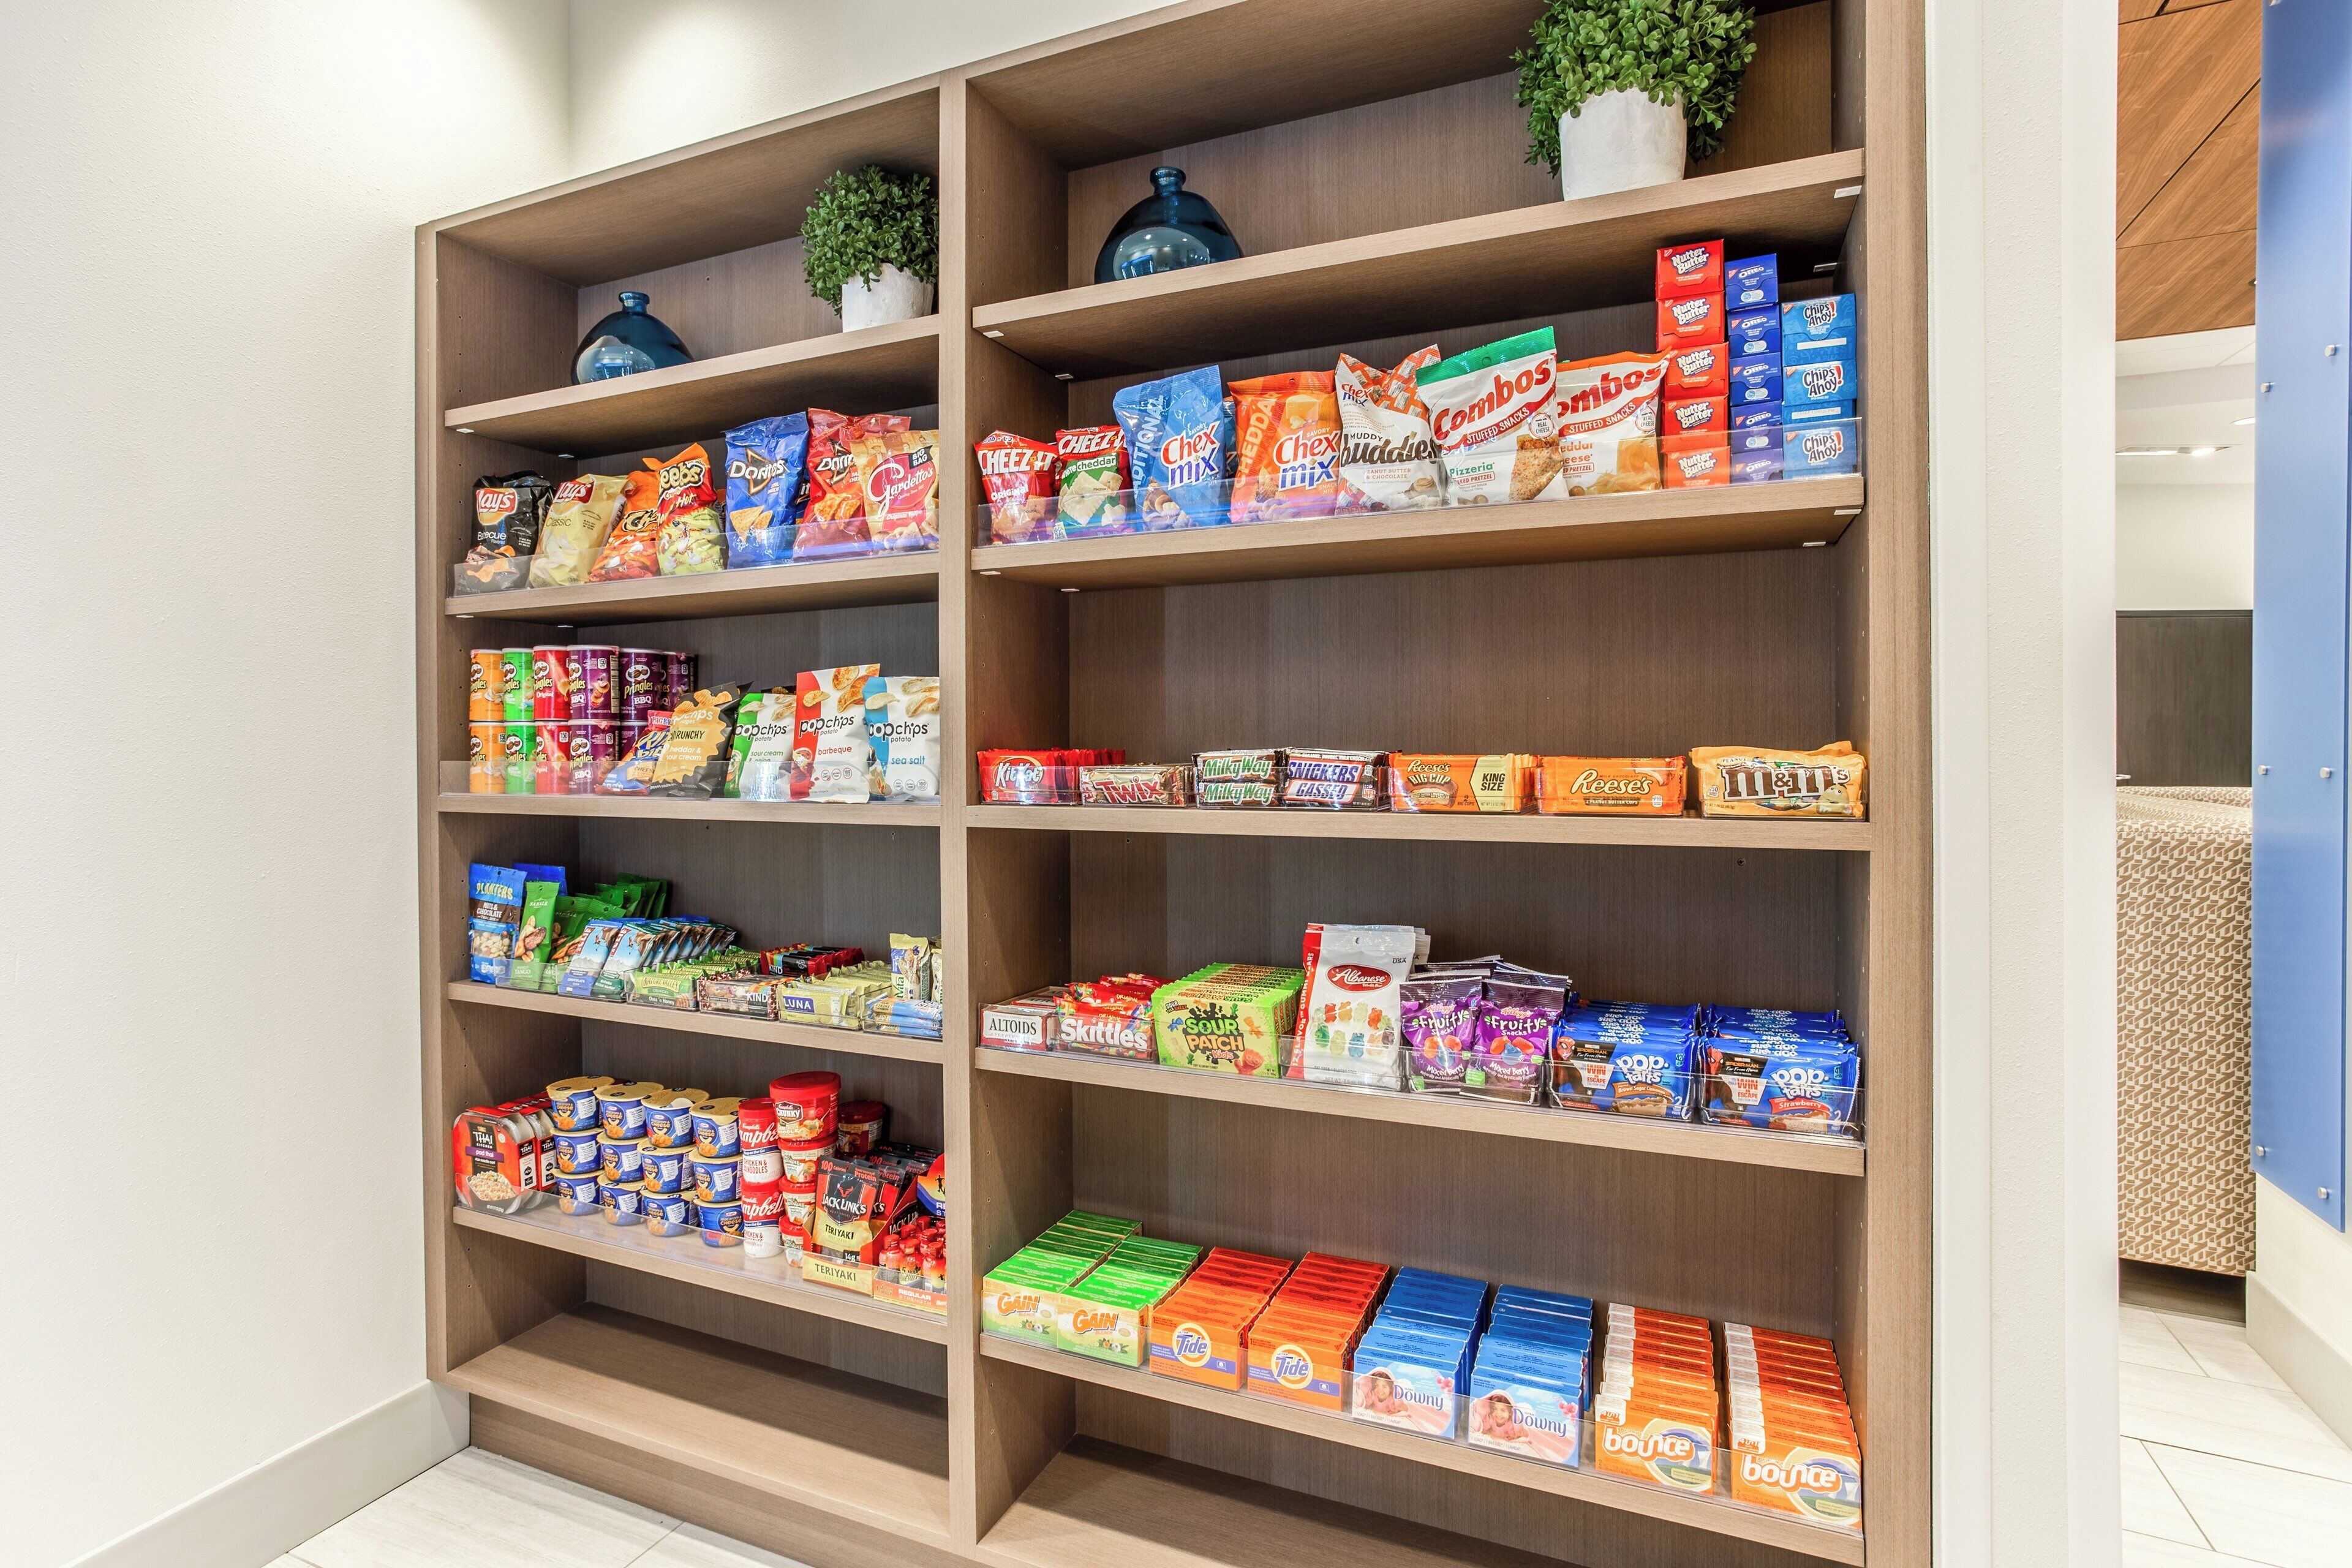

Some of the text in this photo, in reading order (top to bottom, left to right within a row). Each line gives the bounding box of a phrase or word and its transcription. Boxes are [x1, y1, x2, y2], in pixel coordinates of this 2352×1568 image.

[1672, 247, 1705, 266] Nutter
[1677, 254, 1709, 274] Butter
[1739, 266, 1764, 278] OREO
[1672, 298, 1706, 317] Nutter
[1678, 304, 1710, 325] Butter
[1804, 304, 1830, 318] Chips
[1742, 317, 1767, 329] OREO
[1677, 350, 1711, 367] Nutter
[1683, 356, 1715, 375] Butter
[1743, 364, 1769, 375] OREO
[1804, 368, 1835, 386] Chips
[1809, 366, 1842, 397] Ahoy!
[1341, 383, 1372, 398] Chex
[1434, 358, 1553, 440] Combos
[1558, 364, 1662, 418] ombos
[1570, 402, 1636, 433] STUFFED SNACKS
[1675, 402, 1709, 419] Nutter
[1681, 409, 1714, 429] Butter
[1746, 413, 1771, 425] OREO
[1188, 422, 1207, 436] SAVORY
[1306, 427, 1330, 438] SAVORY
[1467, 407, 1529, 444] STUFFED SNACKS
[1161, 423, 1219, 466] Chex
[1350, 432, 1382, 442] MUDDY
[1804, 435, 1835, 452] Chips
[913, 449, 925, 460] BIG
[1275, 431, 1340, 466] Chex
[1341, 434, 1438, 466] buddies
[1809, 432, 1842, 462] Ahoy!
[913, 455, 928, 466] BAG
[1077, 455, 1116, 471] cheddar
[1170, 447, 1218, 488] mix
[1678, 452, 1713, 469] Nutter
[1684, 459, 1717, 478] Butter
[1746, 461, 1771, 472] OREO
[729, 459, 787, 480] Doritos
[1280, 456, 1336, 489] mix
[1449, 464, 1493, 477] Pizzeria
[1471, 474, 1492, 483] PRETZEL
[554, 481, 591, 503] Lay's
[869, 463, 933, 519] Gardetto's
[991, 484, 1029, 500] ORIGINAL
[478, 489, 514, 513] Lay's
[546, 516, 571, 527] Classic
[624, 681, 653, 699] Pringles
[571, 694, 585, 704] BBQ
[634, 696, 652, 704] BBQ
[799, 715, 854, 737] popchips
[818, 745, 853, 755] barbeque
[891, 755, 925, 765] sea salt
[1204, 756, 1273, 780] Milky Way
[1407, 760, 1451, 773] Reese's
[575, 770, 592, 779] BBQ
[1288, 761, 1359, 782] SNICKERS
[1408, 774, 1451, 785] BIG CUP
[1482, 773, 1506, 782] KING
[1481, 782, 1504, 791] SIZE
[1570, 769, 1653, 794] Reese's
[1205, 782, 1275, 805] Milky Way
[476, 882, 513, 900] PLANTERS
[477, 908, 502, 918] CHOCOLATE
[769, 965, 783, 974] KIND
[1331, 968, 1386, 984] Albanese
[747, 992, 768, 1003] KIND
[783, 997, 810, 1010] LUNA
[1166, 1000, 1178, 1009] SOUR
[1419, 1011, 1465, 1029] Fruity
[1501, 1006, 1533, 1019] Kellogg's
[989, 1018, 1036, 1035] ALTOIDS
[1185, 1017, 1238, 1036] SOUR
[1431, 1027, 1453, 1036] Snacks
[1491, 1016, 1540, 1034] Fruity
[1061, 1018, 1147, 1052] Skittles
[1186, 1035, 1245, 1052] PATCH
[1212, 1049, 1234, 1060] Kids
[1427, 1065, 1446, 1076] Mixed
[1490, 1061, 1530, 1075] Mixed Berry
[1675, 1096, 1683, 1105] 2
[1779, 1100, 1822, 1109] Strawberry
[776, 1108, 800, 1118] CHUNKY
[1834, 1110, 1841, 1121] 2
[473, 1131, 492, 1144] THAI
[521, 1145, 532, 1153] THAI
[821, 1160, 834, 1172] 100
[854, 1172, 876, 1181] Protein
[822, 1194, 867, 1214] JACK LINK'S
[825, 1224, 854, 1240] TERIYAKI
[845, 1253, 856, 1261] 14g
[815, 1264, 857, 1281] TERIYAKI
[899, 1289, 931, 1300] REGULAR
[997, 1291, 1040, 1316] GAIN
[1072, 1308, 1119, 1334] GAIN
[1176, 1334, 1208, 1357] Tide
[1275, 1355, 1310, 1378] Tide
[1394, 1384, 1444, 1411] Downy
[1513, 1408, 1567, 1438] Downy
[1605, 1428, 1690, 1458] bounce
[1743, 1454, 1836, 1488] bounce
